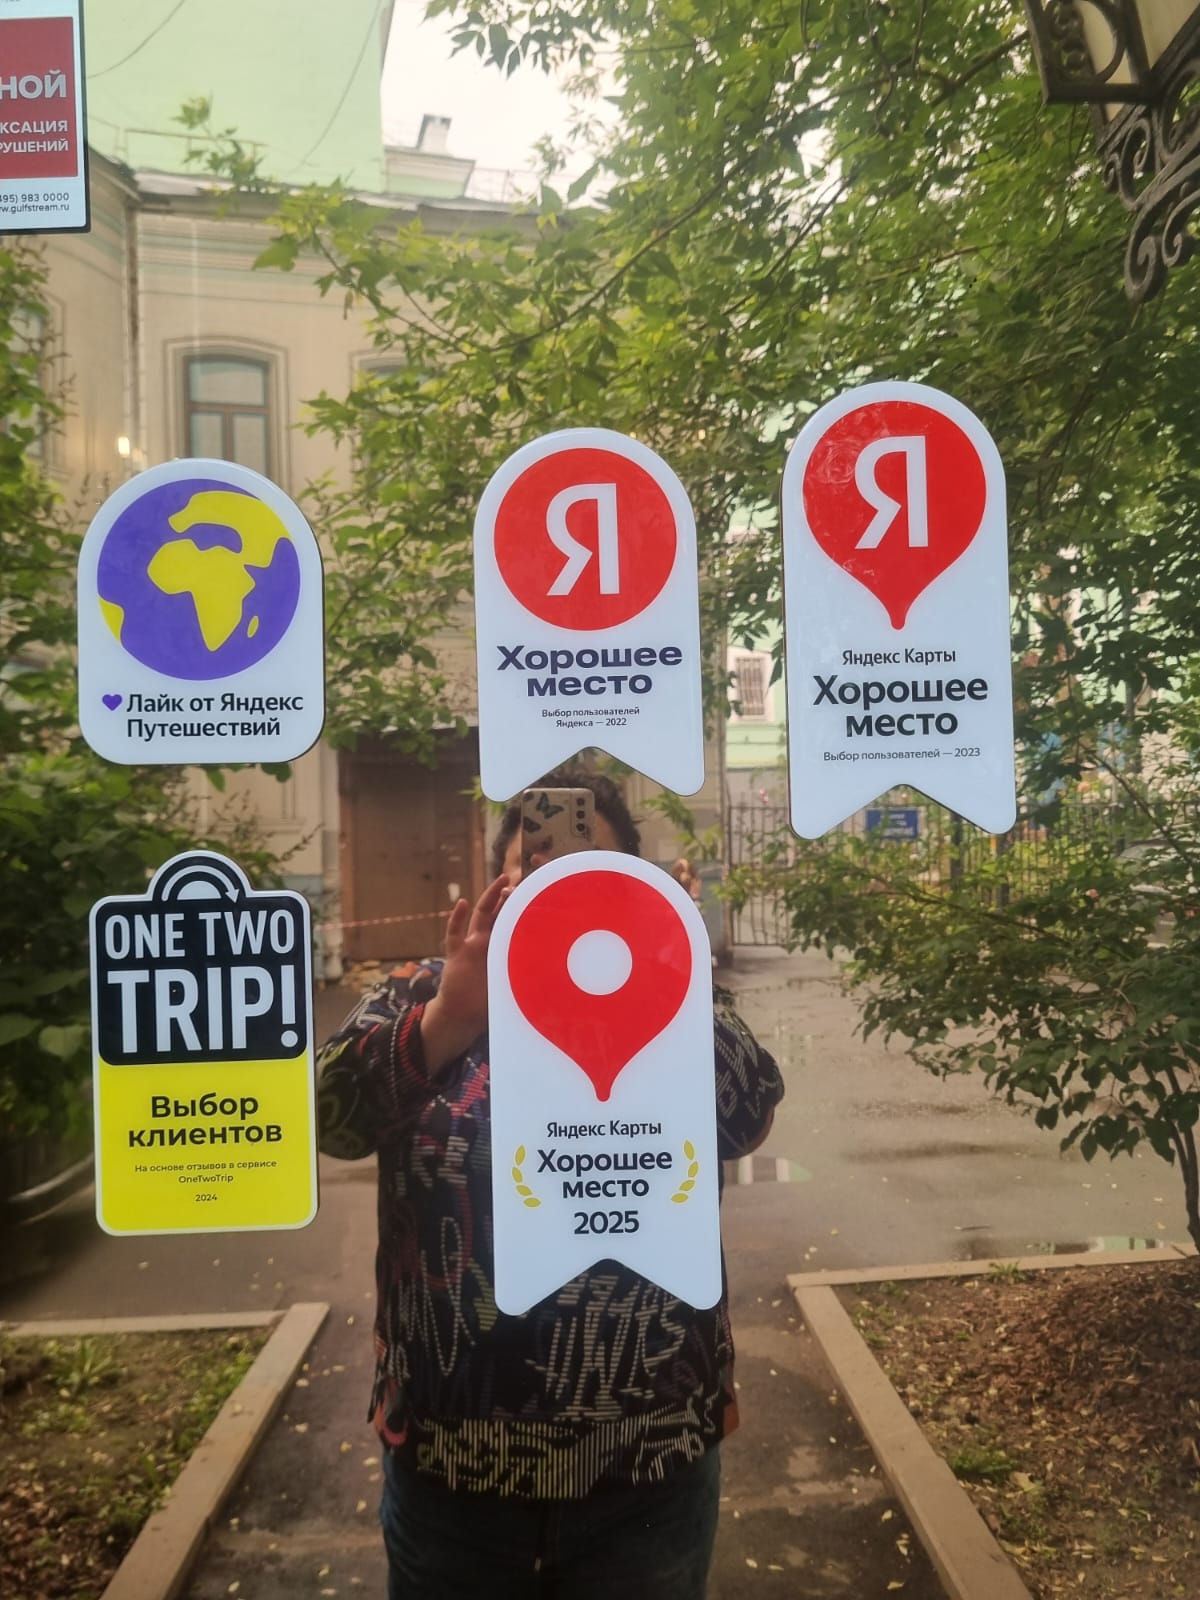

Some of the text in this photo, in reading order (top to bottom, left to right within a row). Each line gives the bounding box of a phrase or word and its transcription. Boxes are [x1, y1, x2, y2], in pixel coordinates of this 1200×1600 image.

[0, 69, 67, 99] НОЙ
[0, 203, 70, 214] w.gulfstream.ru
[21, 193, 40, 203] 983
[43, 192, 70, 202] 0000
[856, 435, 929, 549] Я
[546, 482, 620, 596] Я
[497, 644, 683, 675] Хорошее
[842, 648, 957, 667] Яндекс Карты
[527, 674, 653, 697] место
[812, 674, 989, 711] Хорошее
[126, 692, 304, 715] Лайк от Яндекс
[542, 706, 641, 718] Выбор пользователей
[127, 717, 281, 742] Путешествий
[556, 719, 594, 728] Яндекса
[605, 718, 627, 727] 2022
[845, 712, 959, 738] место
[823, 751, 859, 761] Выбор
[861, 749, 941, 760] пользователей
[954, 747, 981, 758] 2023
[104, 909, 296, 960] ONE TWO
[106, 964, 299, 1054] TRIP!
[151, 1092, 259, 1121] Выбор
[128, 1124, 283, 1148] клиентов
[547, 1120, 662, 1139] Яндекс Карты
[135, 1159, 278, 1173] На основе отзывов в сервисе
[537, 1149, 673, 1177] Хорошее
[178, 1173, 234, 1184] OneTwoTrip
[562, 1179, 650, 1199] место
[195, 1193, 218, 1203] 2024
[573, 1210, 641, 1235] 2025
